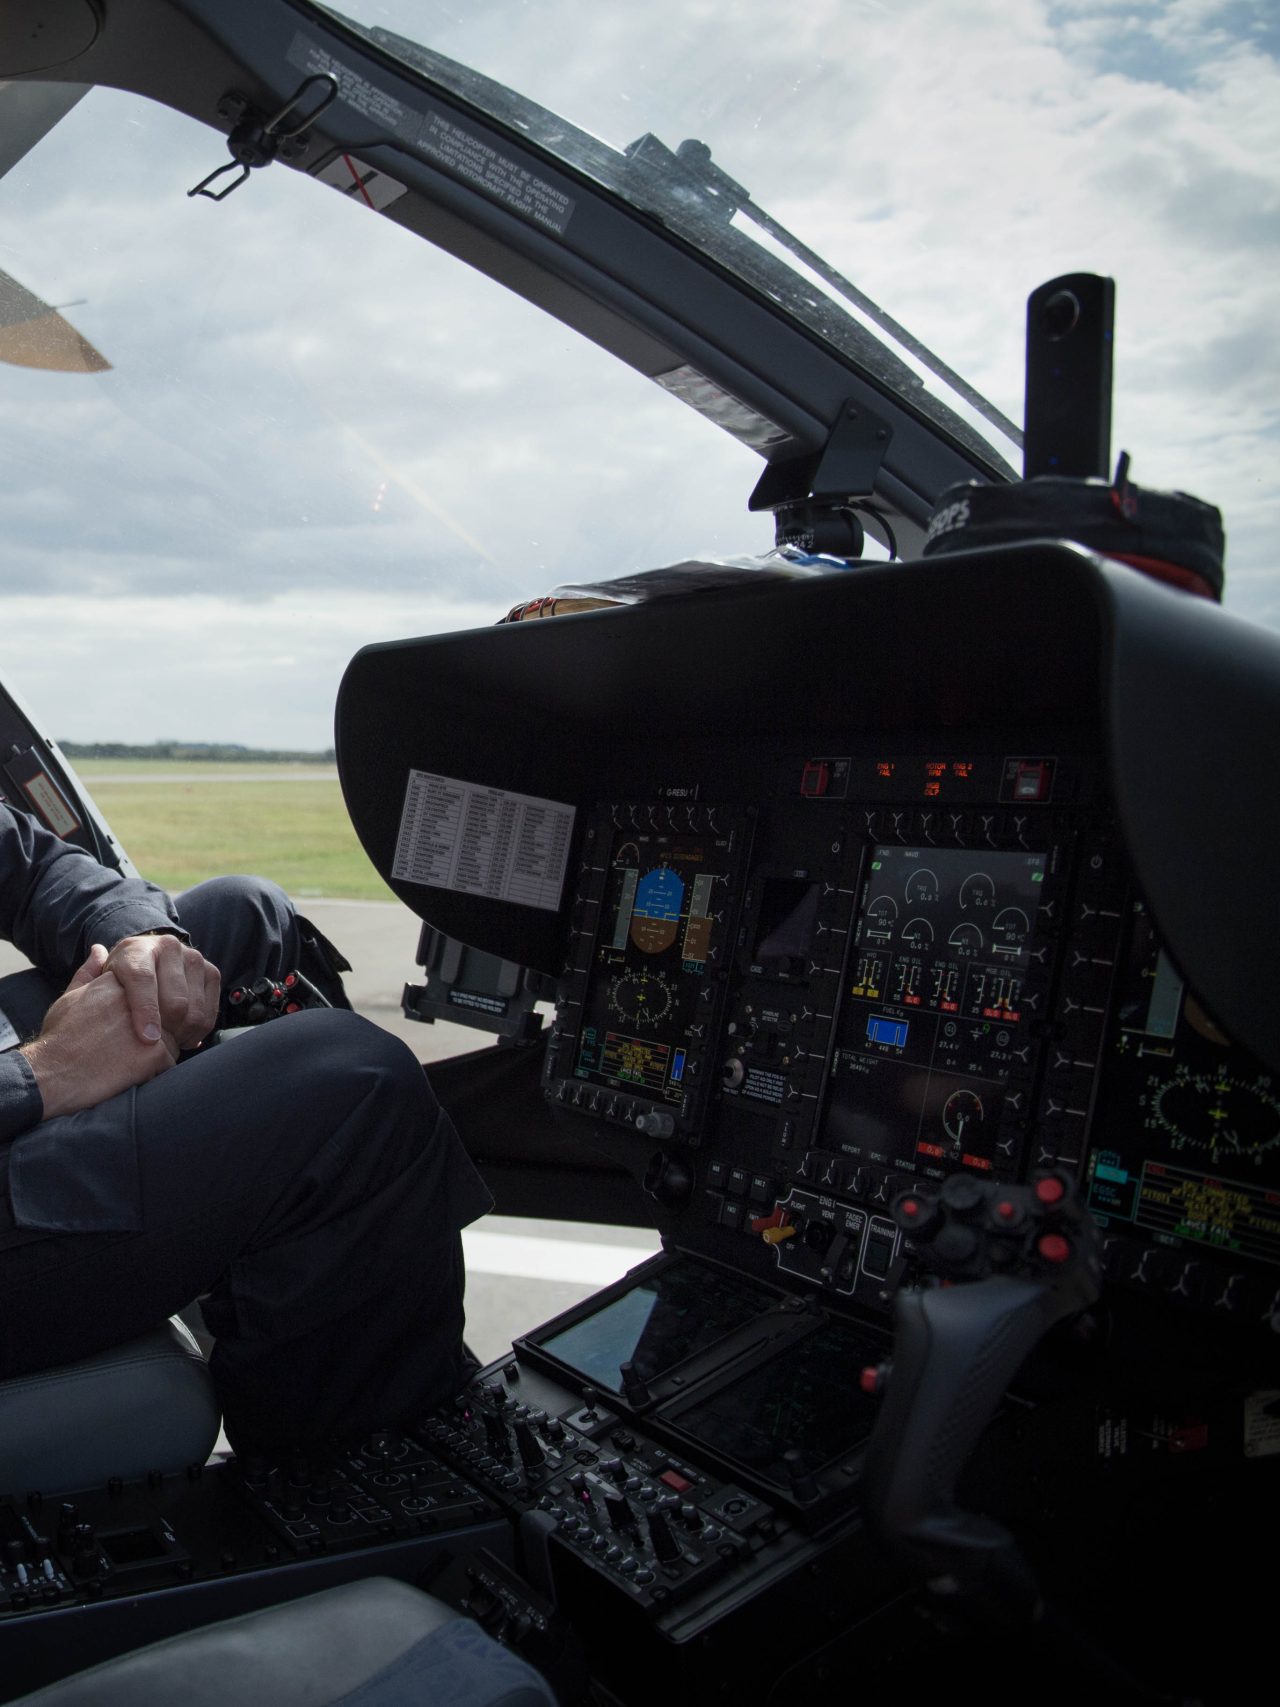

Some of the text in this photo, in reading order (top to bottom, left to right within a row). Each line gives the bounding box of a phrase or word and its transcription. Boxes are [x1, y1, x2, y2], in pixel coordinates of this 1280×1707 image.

[433, 116, 569, 205] THIS HELICOPTER MUST BE OPERATED
[429, 125, 566, 214] IN COMPLIANCE WITH THE OPERATING
[440, 143, 549, 214] LIMITATIONS SPECIFIED IN THE
[416, 140, 562, 232] APPROVED ROTORCRAFT FLIGHT MANUAL
[876, 762, 890, 770] ENG
[926, 762, 947, 770] ROTOR
[953, 762, 966, 770] ENG
[879, 769, 891, 777] FAIL
[928, 769, 943, 777] RPM
[955, 769, 968, 777] FAIL
[1176, 1064, 1189, 1075] 24
[1146, 1075, 1159, 1086] 21
[1144, 1117, 1157, 1129] 15
[1170, 1137, 1184, 1150] 12
[895, 1159, 916, 1170] STATUS
[791, 1201, 807, 1211] FLIGHT
[819, 1196, 833, 1207] ENG
[821, 1210, 835, 1220] VENT
[846, 1212, 863, 1224] FADEC
[845, 1220, 861, 1231] EMER
[871, 1223, 896, 1239] TRAINING
